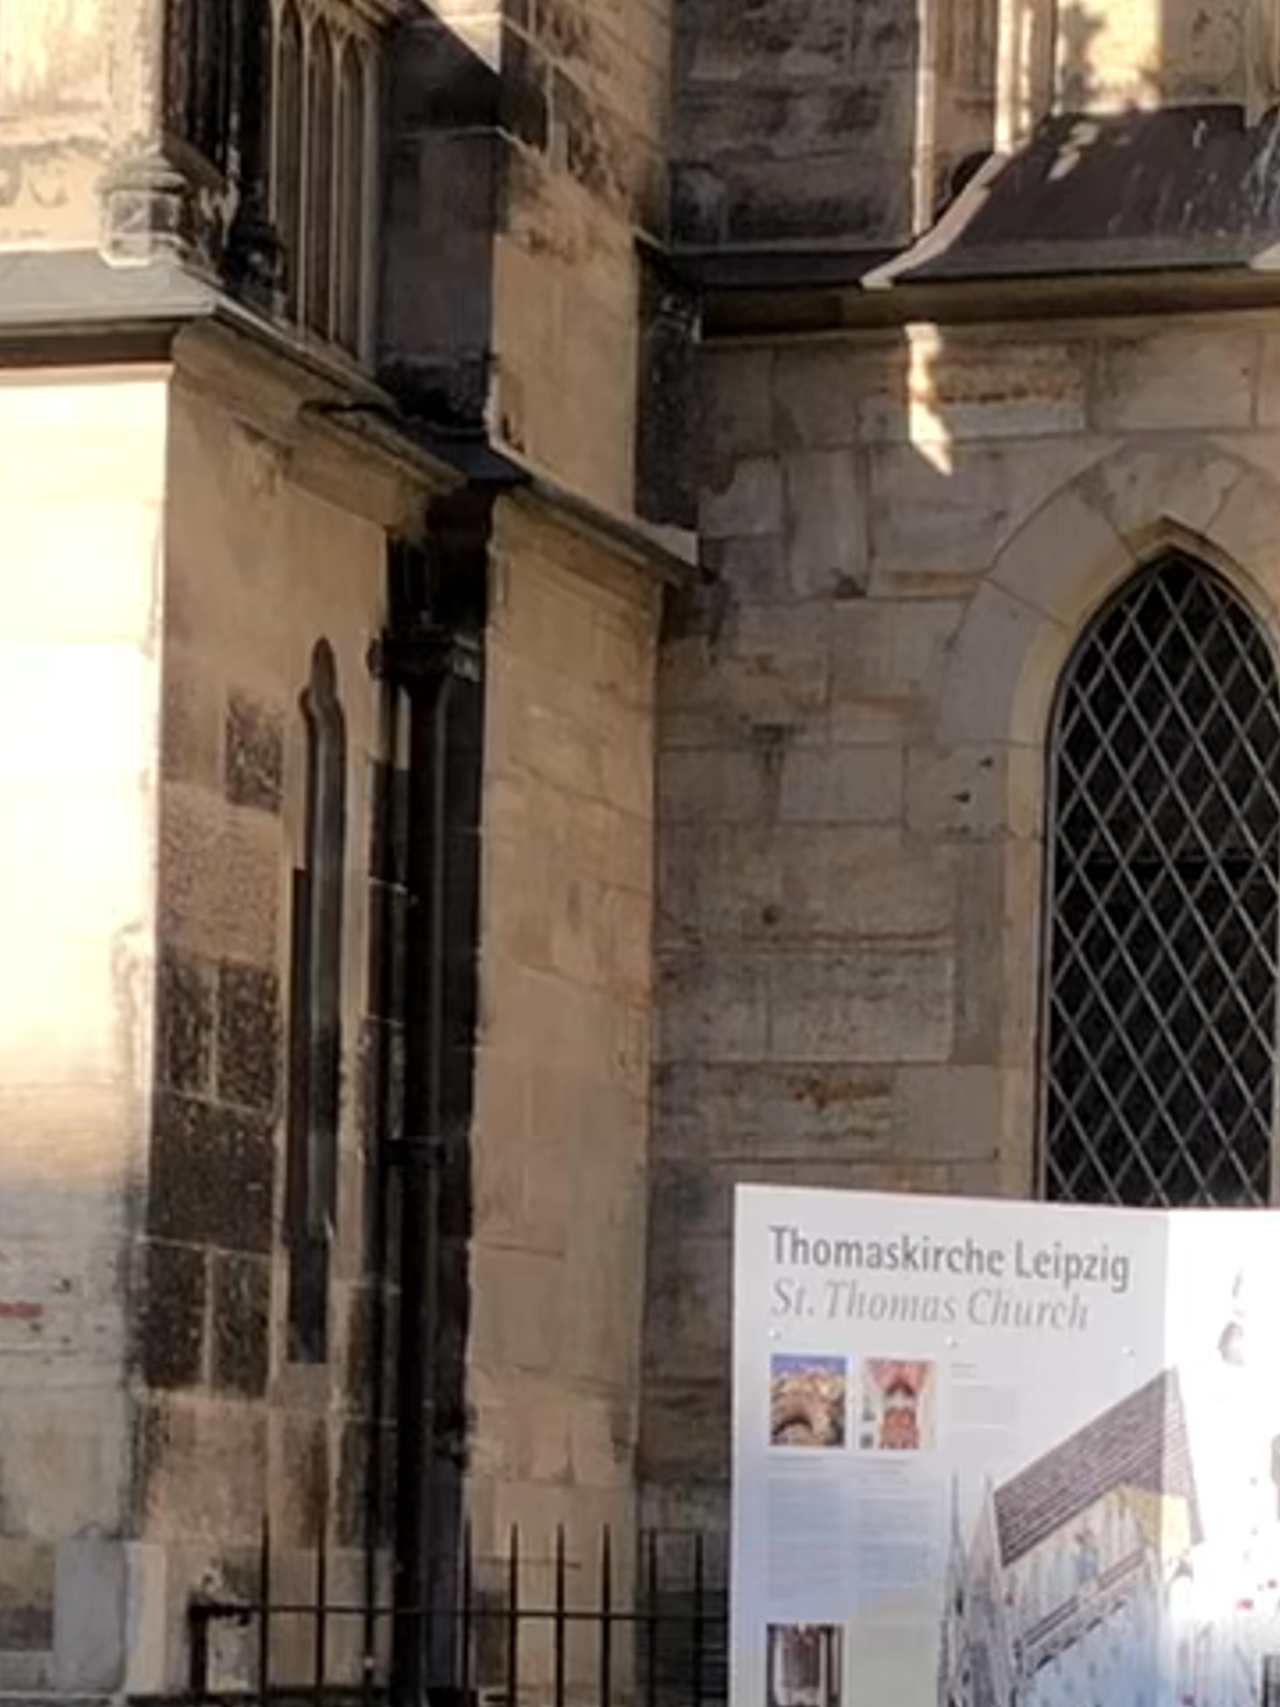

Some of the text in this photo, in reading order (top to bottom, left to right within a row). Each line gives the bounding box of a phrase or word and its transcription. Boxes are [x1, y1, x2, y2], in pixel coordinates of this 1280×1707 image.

[769, 1225, 1130, 1293] Thomaskirche Leipzig
[770, 1277, 1089, 1330] St. Thomas Church
